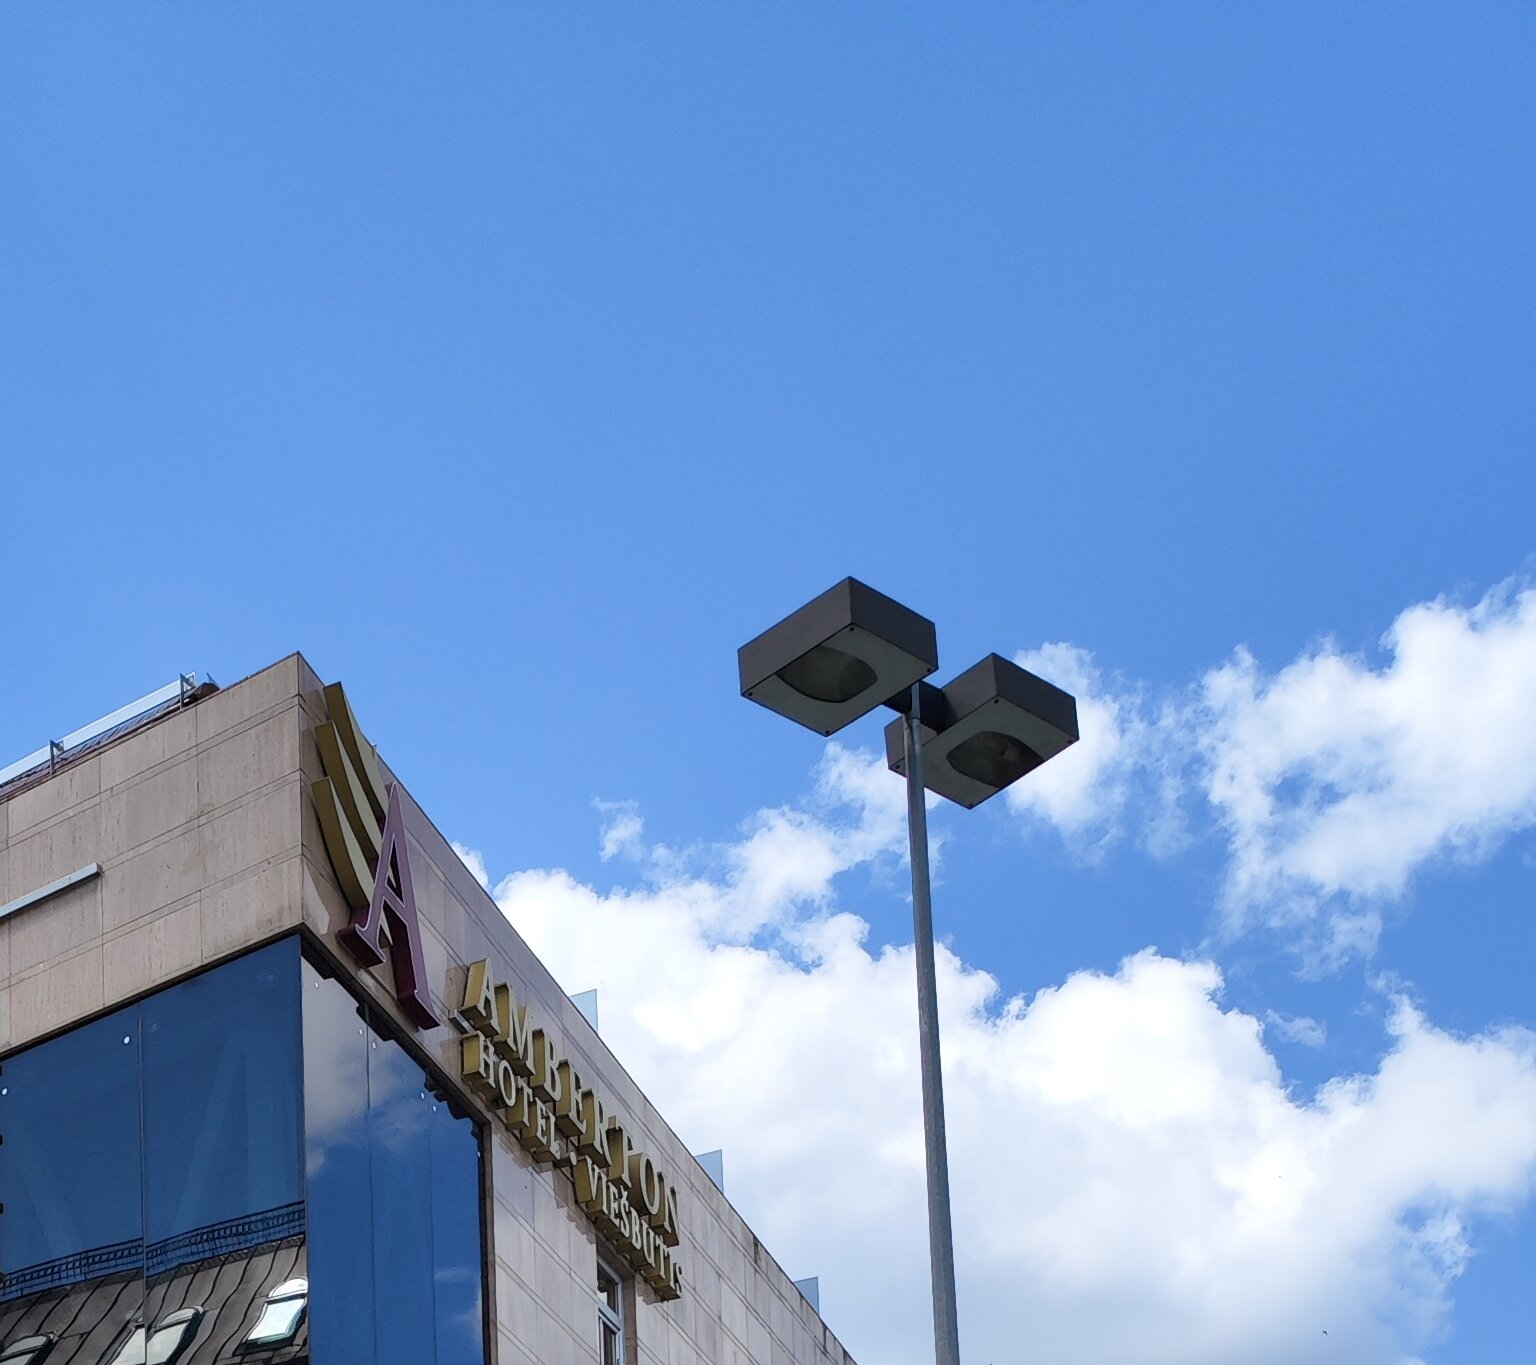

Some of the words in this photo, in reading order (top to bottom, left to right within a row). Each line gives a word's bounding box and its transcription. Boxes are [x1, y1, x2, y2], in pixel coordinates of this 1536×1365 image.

[462, 957, 681, 1247] AMBERTON
[464, 1033, 562, 1164] HOTEL
[576, 1155, 684, 1300] VIEŠBUTIS
